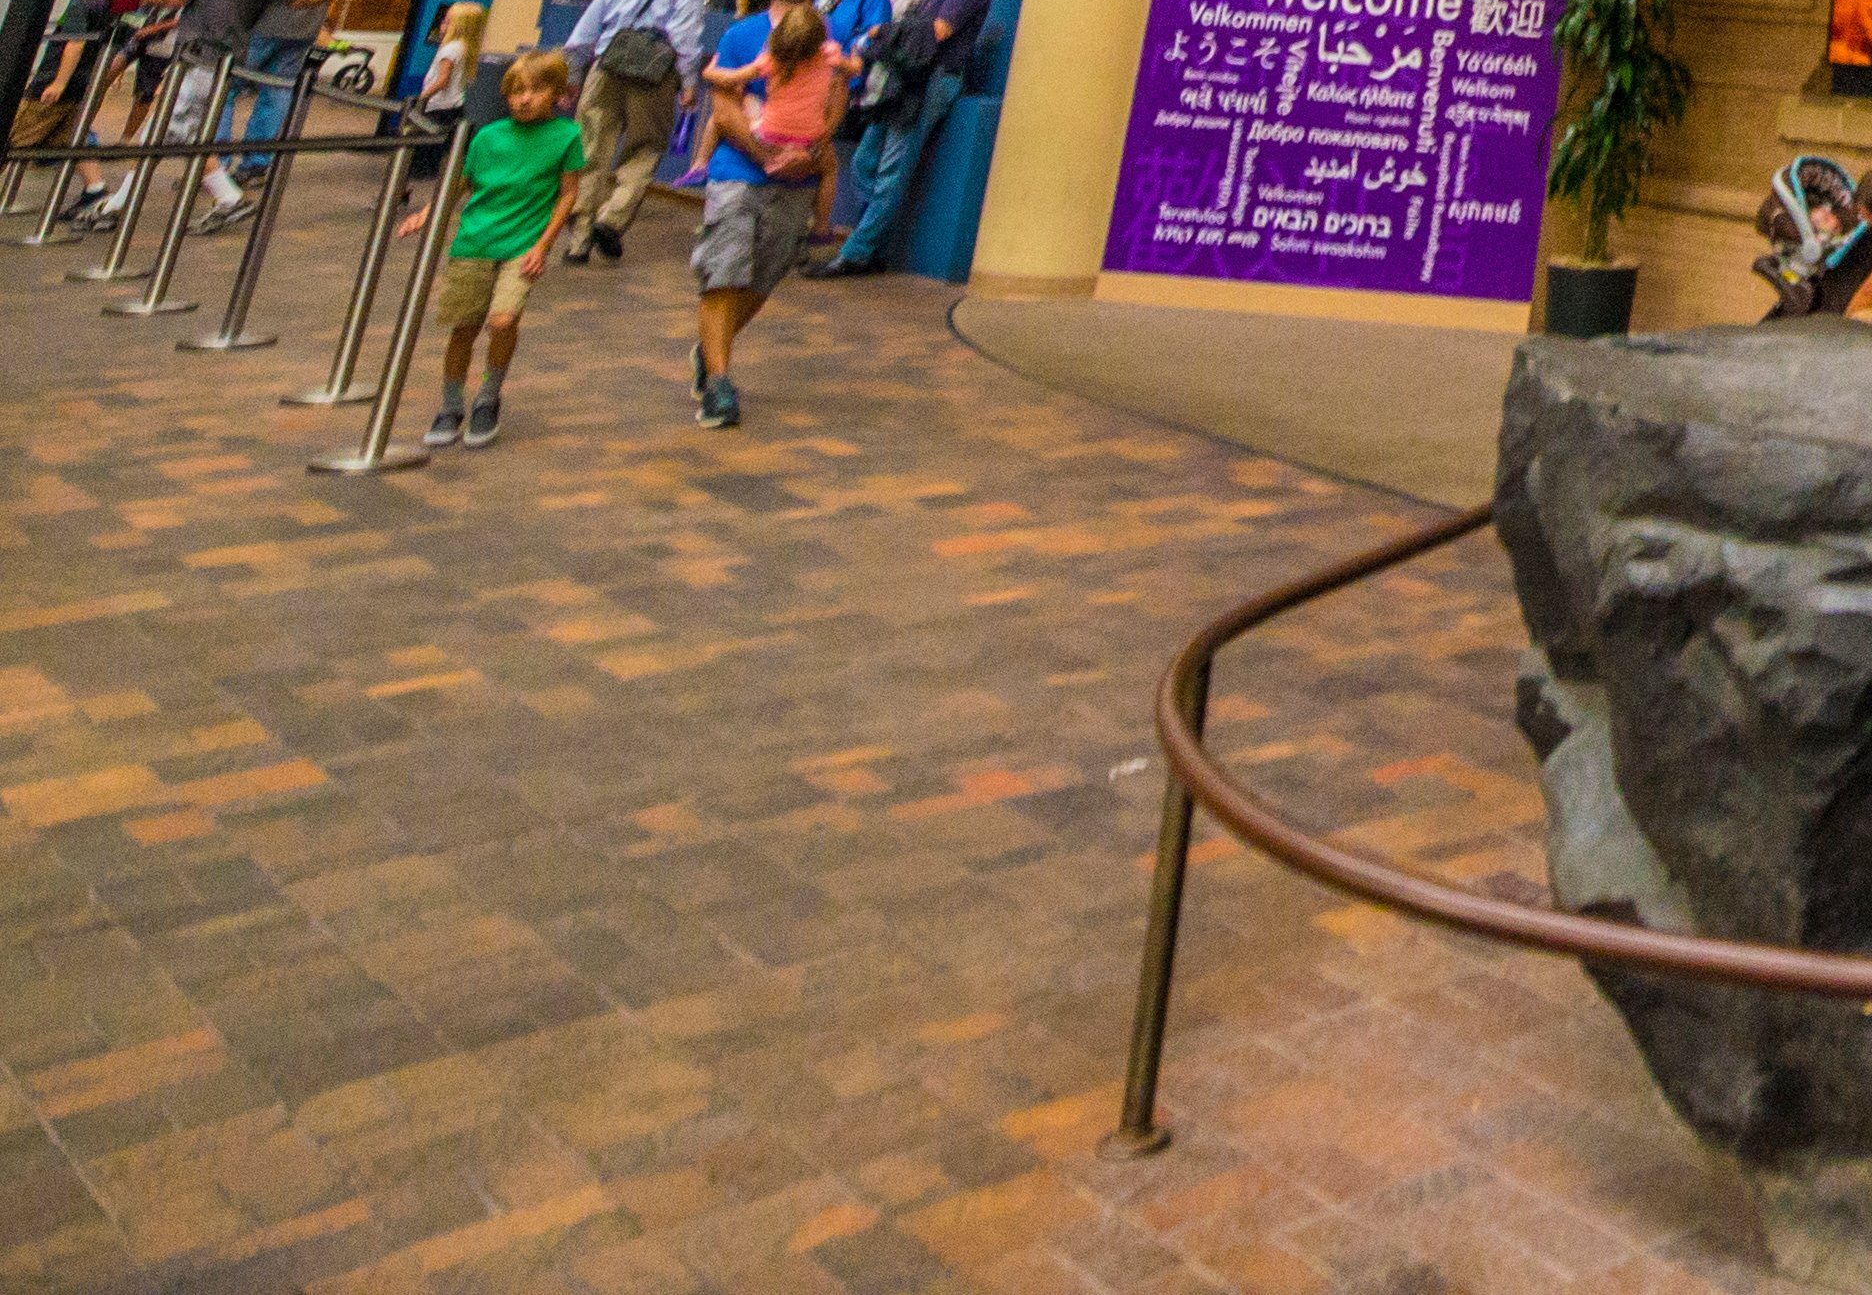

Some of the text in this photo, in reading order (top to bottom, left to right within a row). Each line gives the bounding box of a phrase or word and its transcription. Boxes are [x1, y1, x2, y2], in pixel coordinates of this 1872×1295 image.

[1190, 2, 1313, 33] Velkommen
[1165, 31, 1282, 70] ようこそ
[1417, 30, 1454, 154] Benvenuti
[1452, 77, 1516, 100] Welkom
